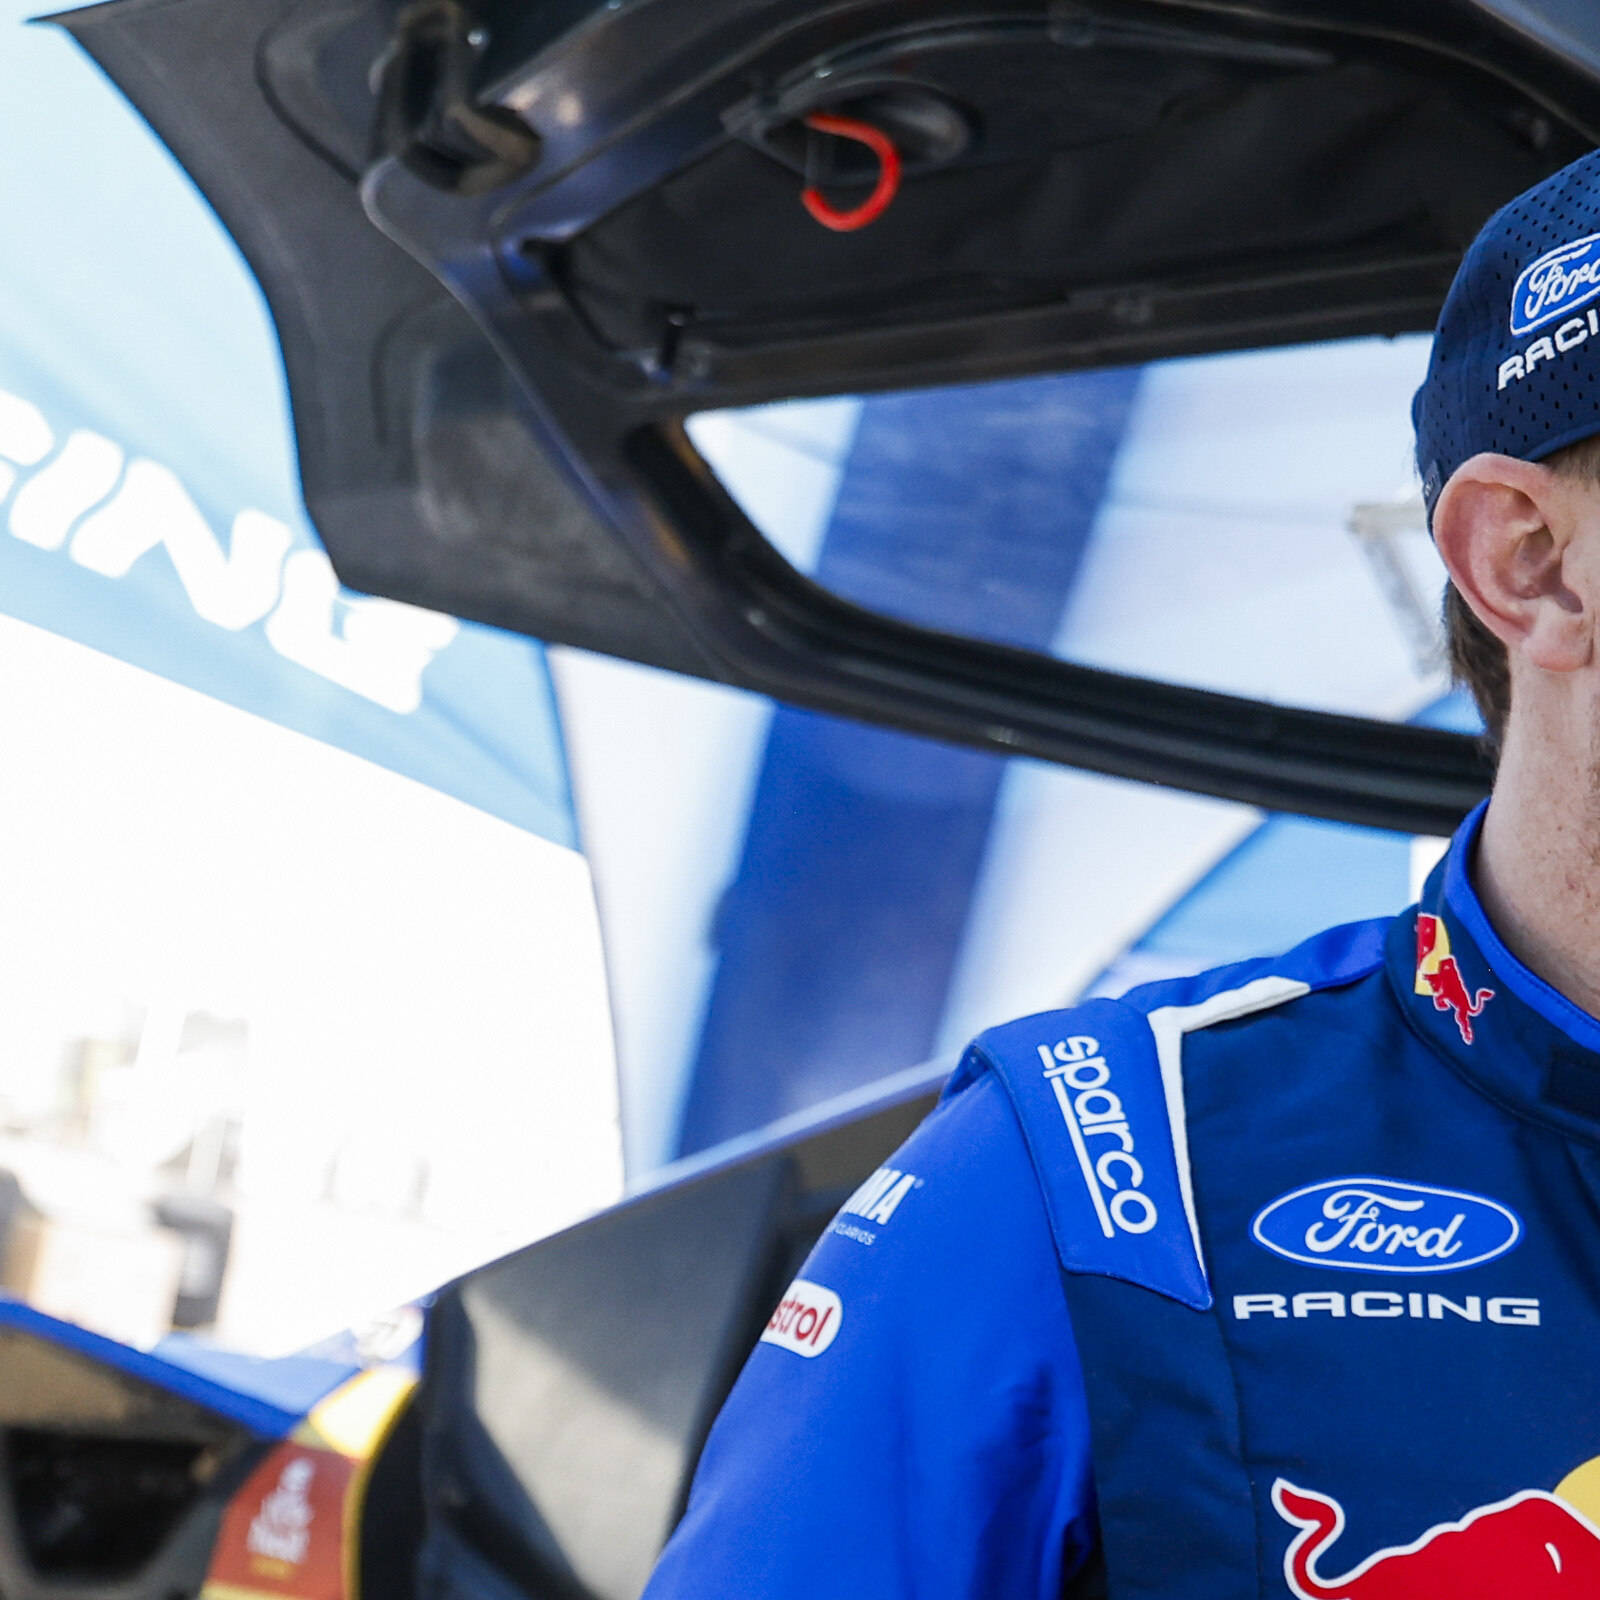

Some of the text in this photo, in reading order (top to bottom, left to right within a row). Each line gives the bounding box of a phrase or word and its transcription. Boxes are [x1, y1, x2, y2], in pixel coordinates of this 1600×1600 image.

[1040, 1036, 1158, 1237] sparco
[1304, 1188, 1466, 1259] Ford
[1232, 1290, 1541, 1327] RACING
